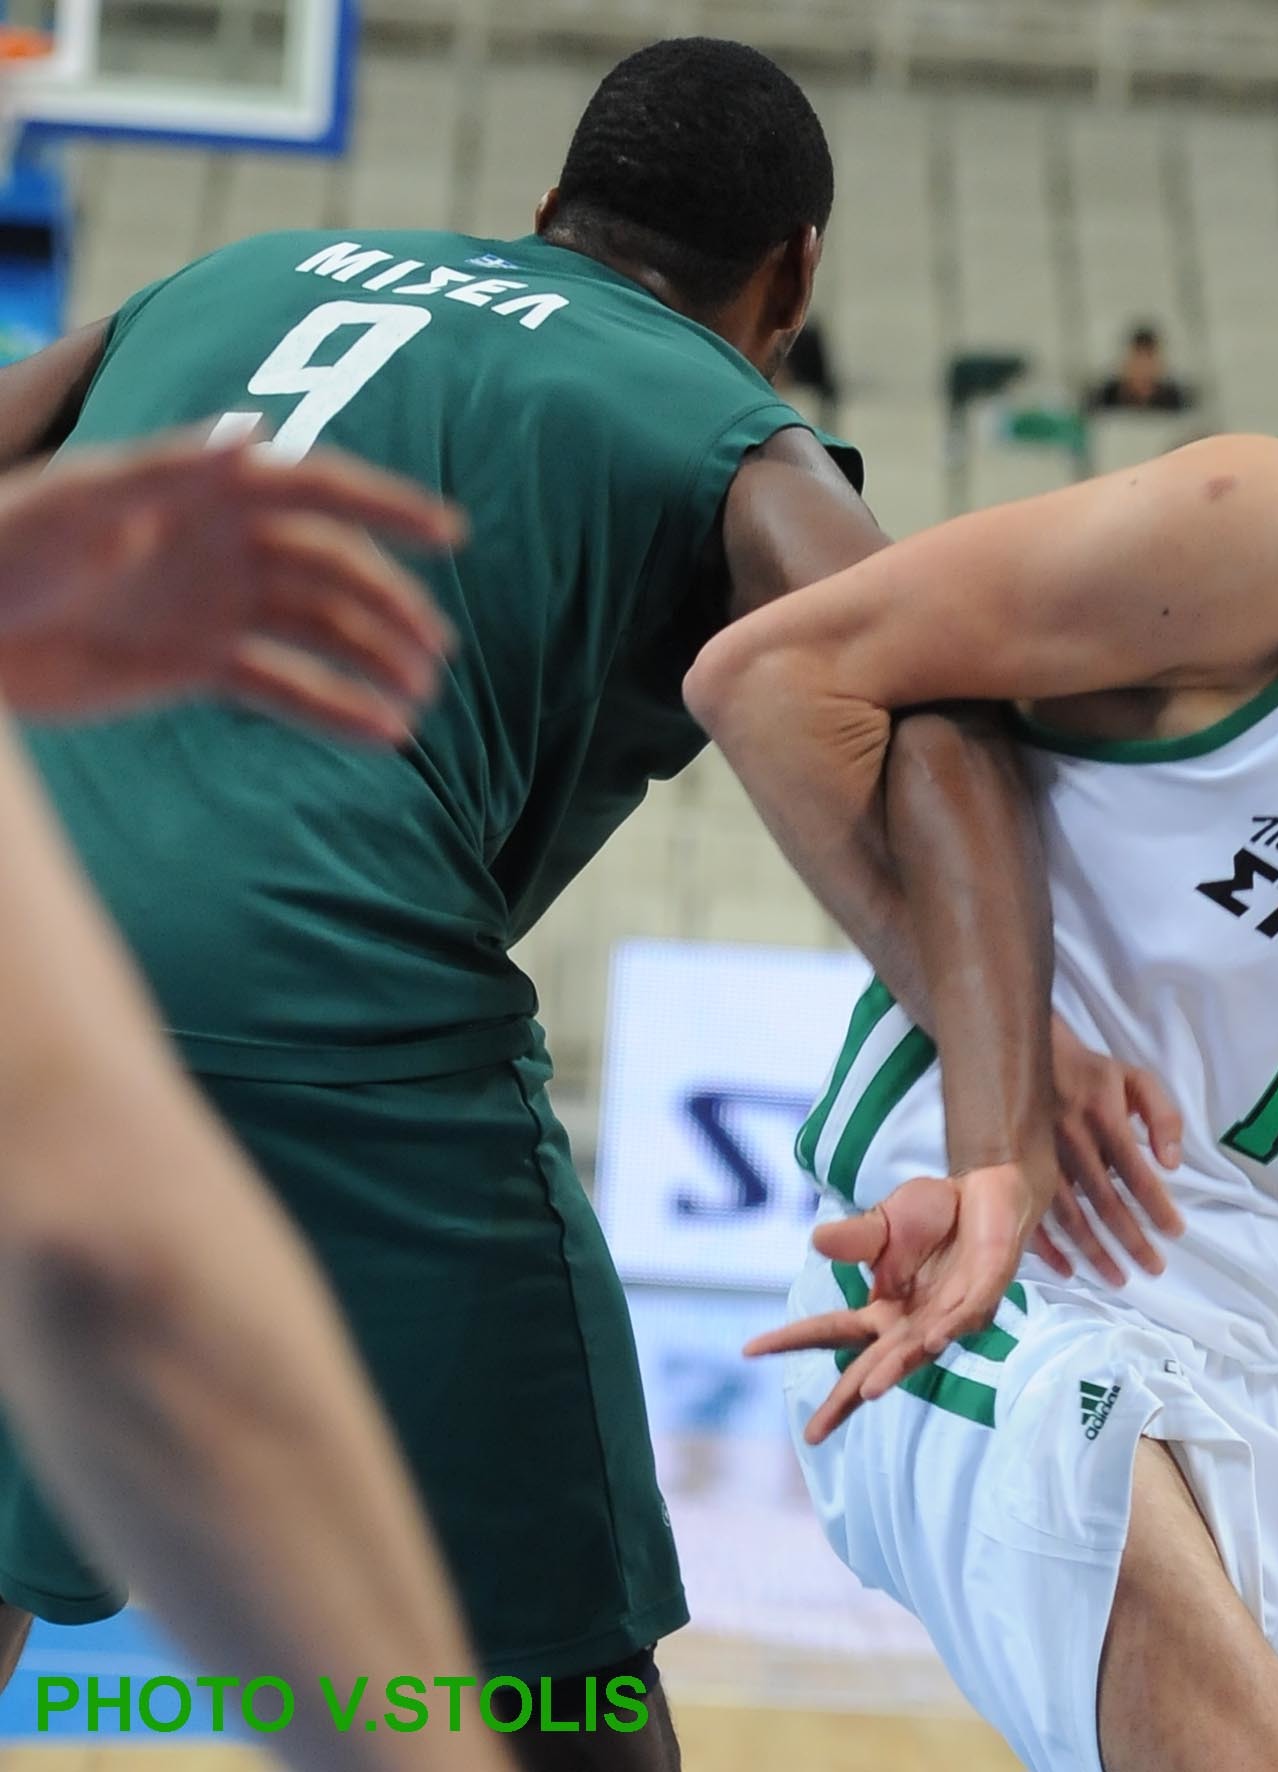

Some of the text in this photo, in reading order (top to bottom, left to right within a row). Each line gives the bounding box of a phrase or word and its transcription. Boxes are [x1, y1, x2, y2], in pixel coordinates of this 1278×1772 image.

[294, 241, 570, 330] ΜΙΣΕΛ
[204, 300, 432, 469] 9
[1085, 1384, 1121, 1440] adidas
